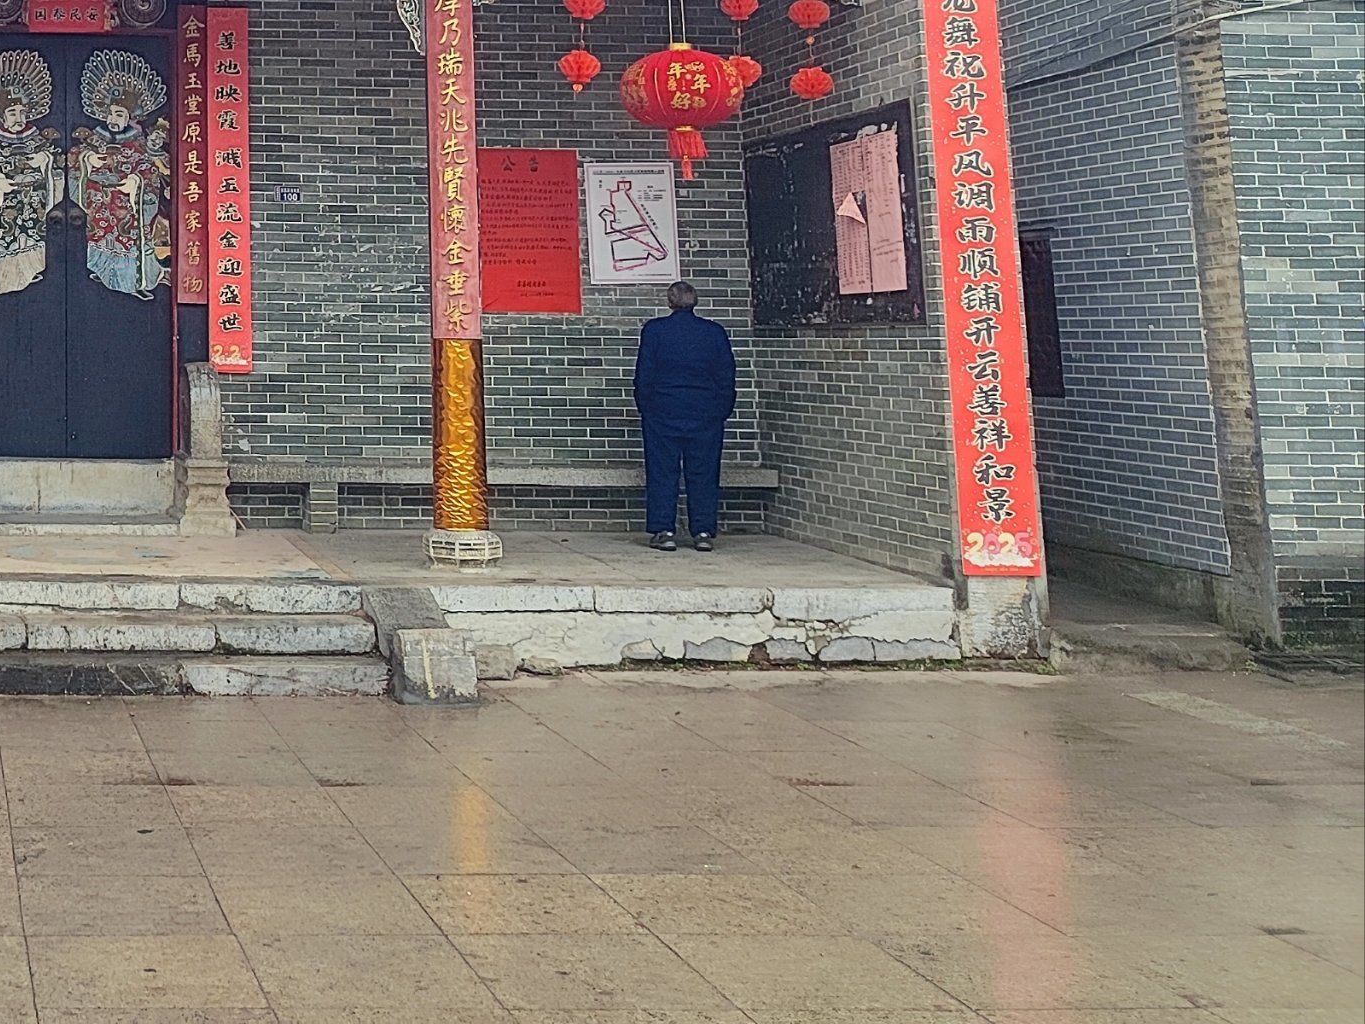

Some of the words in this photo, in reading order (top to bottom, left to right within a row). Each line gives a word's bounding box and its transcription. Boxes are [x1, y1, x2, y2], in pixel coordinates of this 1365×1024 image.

[35, 8, 99, 22] 国泰民安
[181, 14, 205, 292] 金馬玉堂原是吾家舊物
[283, 193, 298, 201] 100
[966, 532, 1033, 557] 2025
